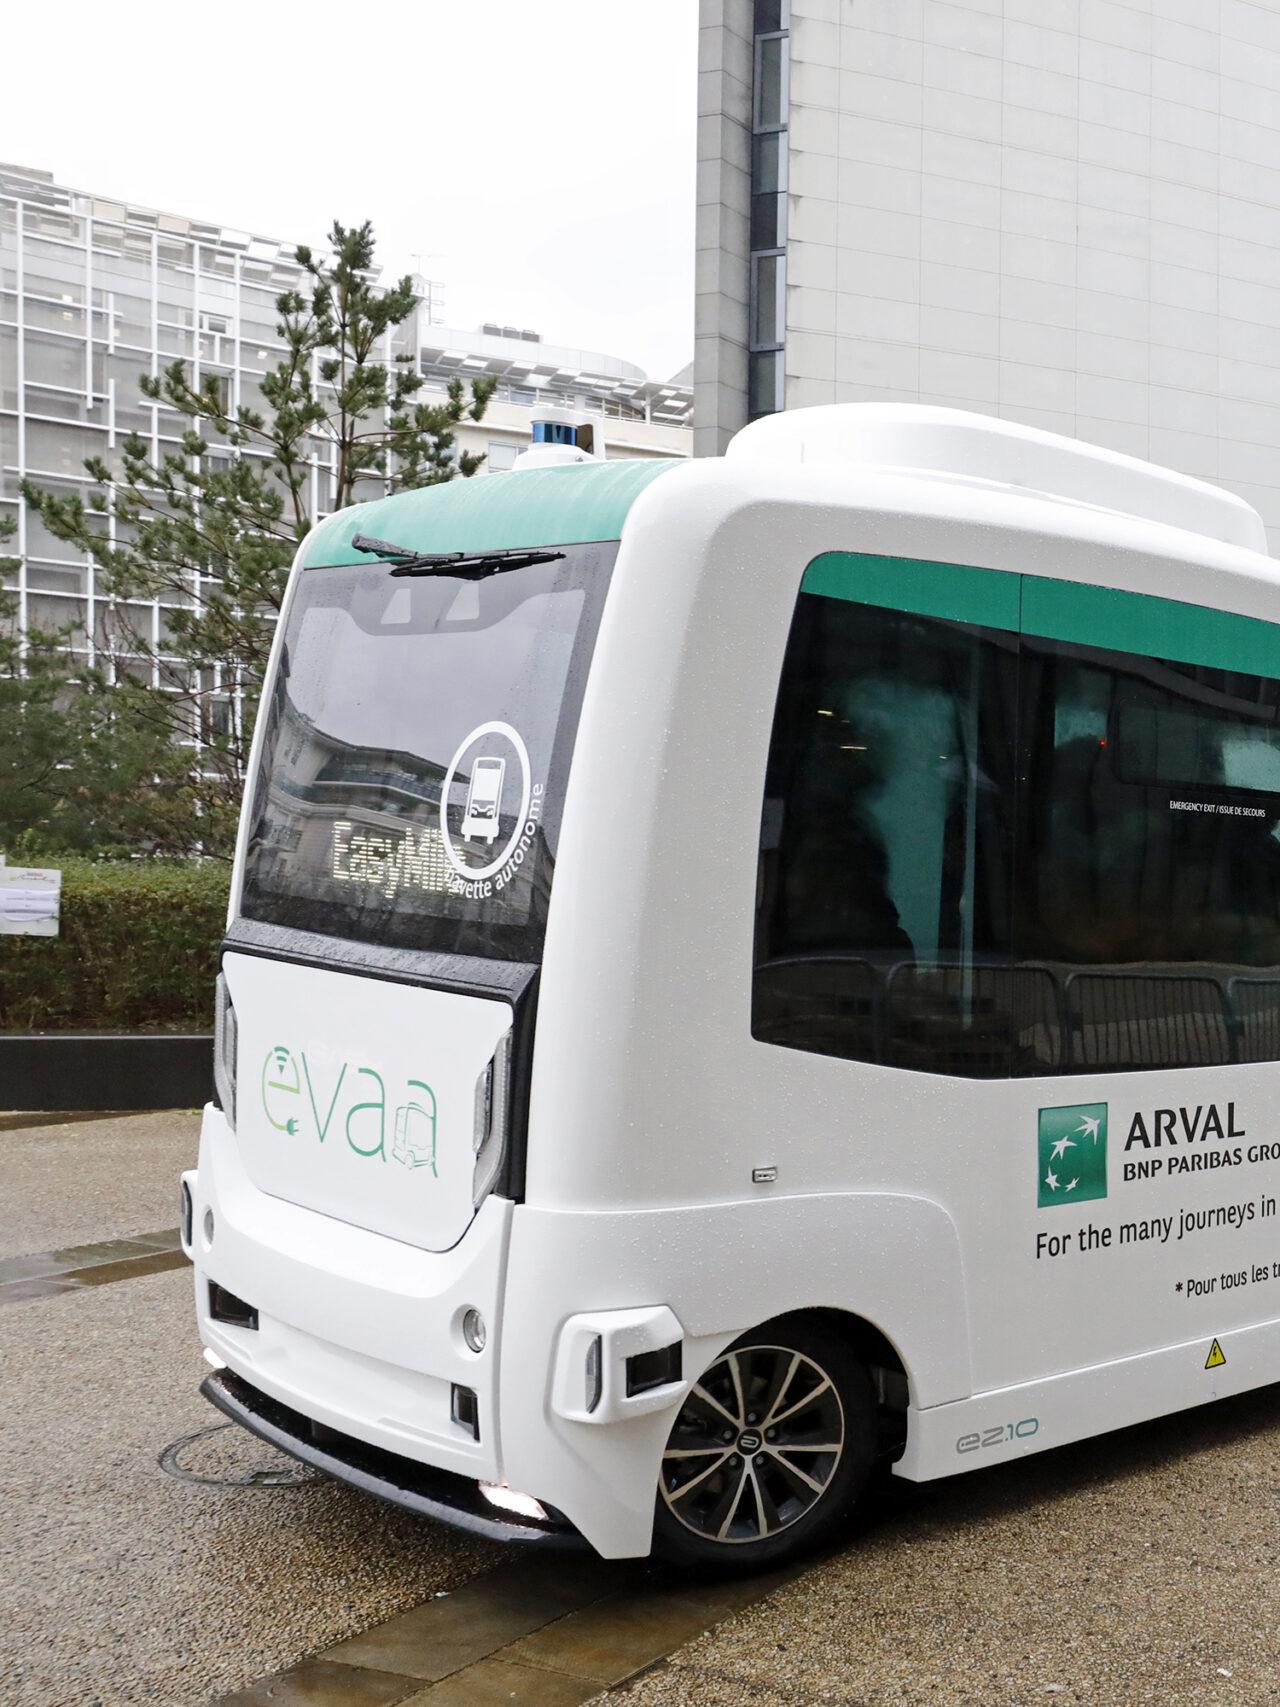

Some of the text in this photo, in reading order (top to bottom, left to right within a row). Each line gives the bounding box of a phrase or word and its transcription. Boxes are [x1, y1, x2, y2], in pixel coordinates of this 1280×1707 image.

[1169, 800, 1203, 812] EMERGENCY
[1203, 804, 1216, 813] EXIT
[1219, 805, 1234, 815] ISSUE
[1234, 806, 1242, 815] DE
[1242, 807, 1266, 818] SECOURS
[445, 783, 544, 900] navette autonome
[1124, 1101, 1246, 1151] ARVAL
[1123, 1159, 1163, 1181] BNP
[1167, 1148, 1243, 1174] PARIBAS
[1036, 1232, 1072, 1259] For
[1078, 1223, 1112, 1251] the
[1119, 1215, 1173, 1244] many
[1177, 1200, 1255, 1240] journeys
[1261, 1195, 1276, 1218] in
[1186, 1277, 1217, 1298] Pour
[1220, 1270, 1248, 1290] tous
[1251, 1264, 1269, 1283] les
